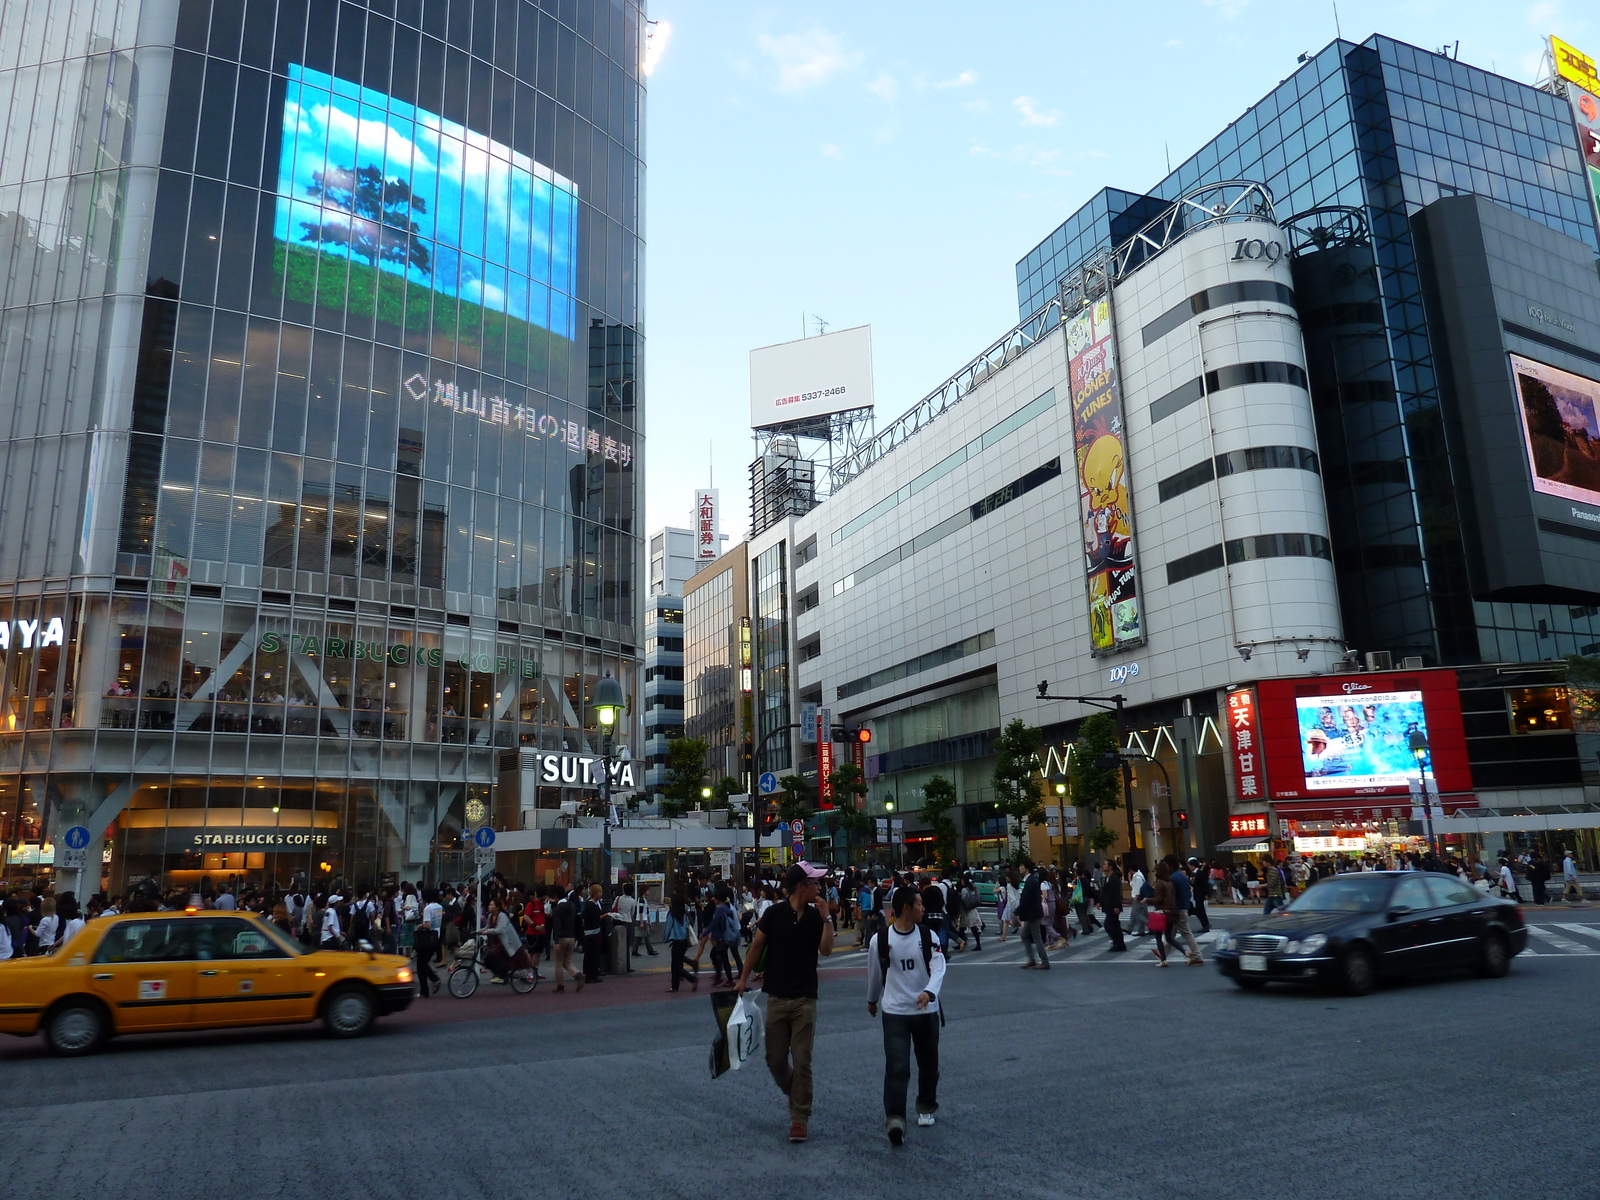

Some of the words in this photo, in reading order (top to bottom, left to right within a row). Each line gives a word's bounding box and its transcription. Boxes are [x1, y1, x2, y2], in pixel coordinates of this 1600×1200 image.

[775, 395, 801, 407] 広告募集
[801, 386, 846, 402] 5337-2468
[1072, 368, 1112, 411] LOONEY
[1081, 388, 1113, 423] TUNES
[700, 494, 714, 546] 大和証券
[1103, 585, 1122, 610] WHAT
[260, 630, 444, 668] STARBUCKS
[1341, 682, 1372, 694] Glico
[1229, 693, 1251, 708] 名物
[1233, 707, 1258, 796] 天津甘栗
[1230, 818, 1266, 832] 天津甘栗
[194, 834, 283, 845] STARBUCKS
[286, 834, 328, 845] COFFEE
[900, 958, 915, 972] 10
